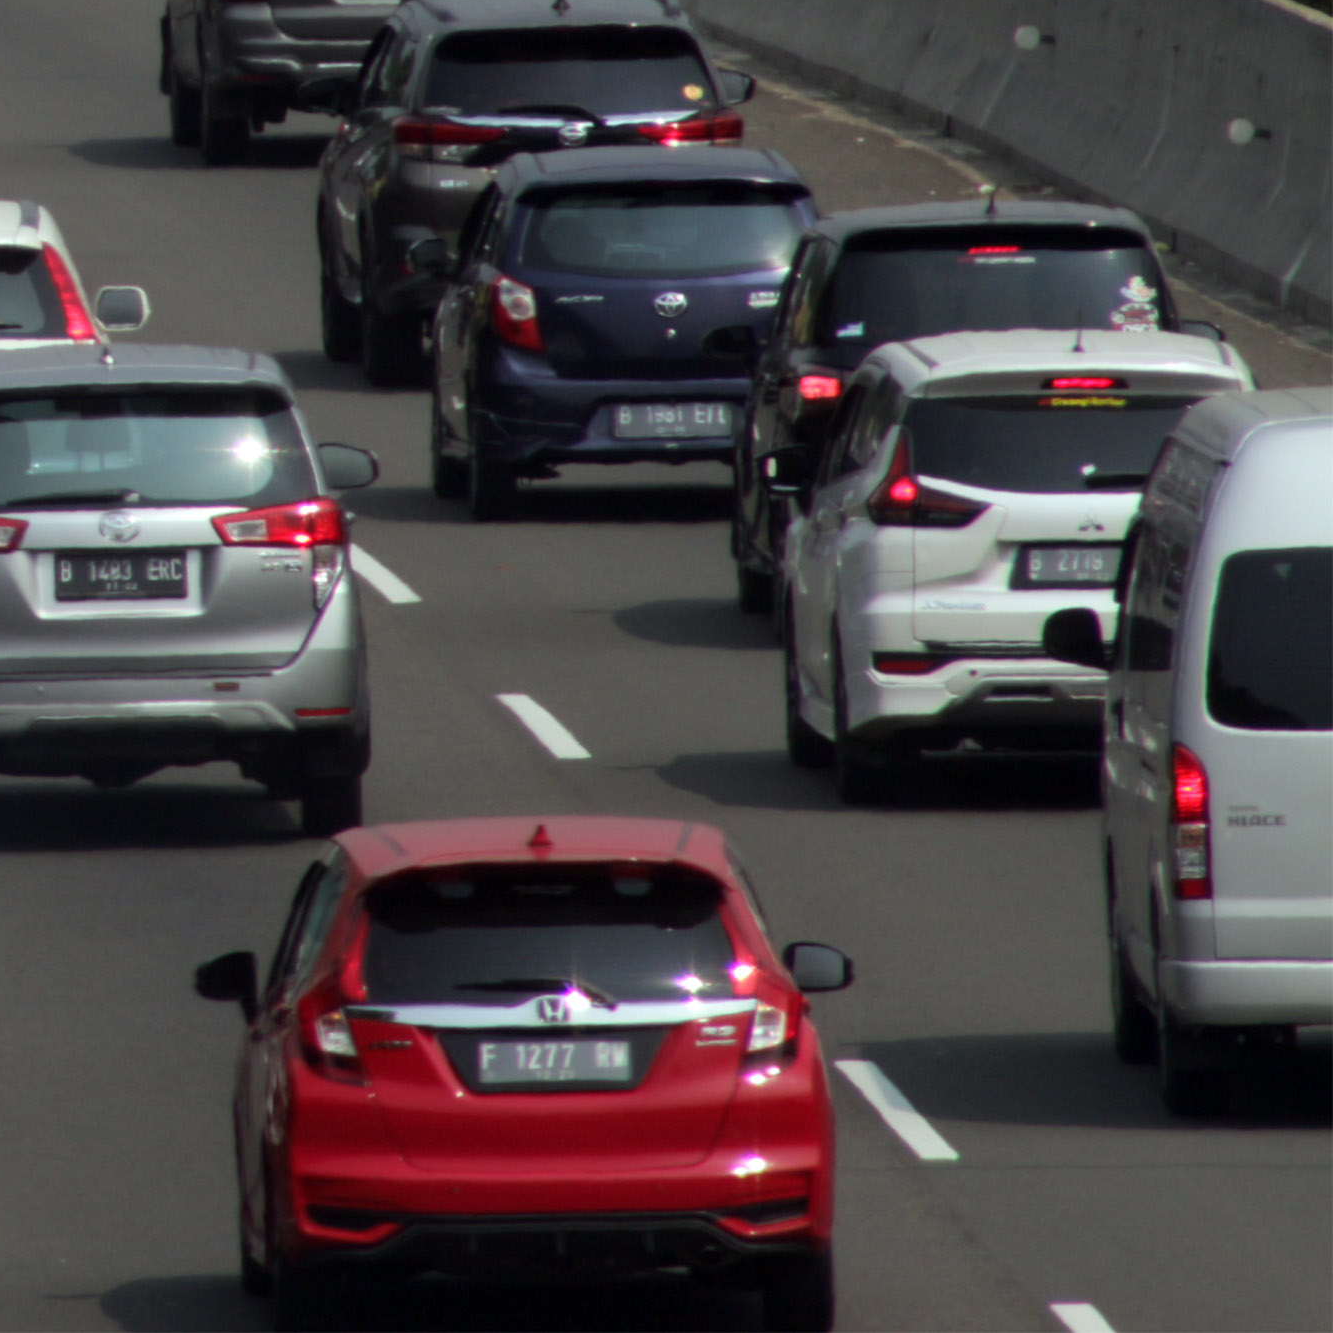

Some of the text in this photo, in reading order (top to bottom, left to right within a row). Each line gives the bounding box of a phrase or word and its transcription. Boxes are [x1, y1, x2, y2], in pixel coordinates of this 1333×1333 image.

[61, 560, 72, 582] B
[147, 557, 183, 580] ERC
[480, 1044, 495, 1068] F
[515, 1044, 573, 1068] 1277
